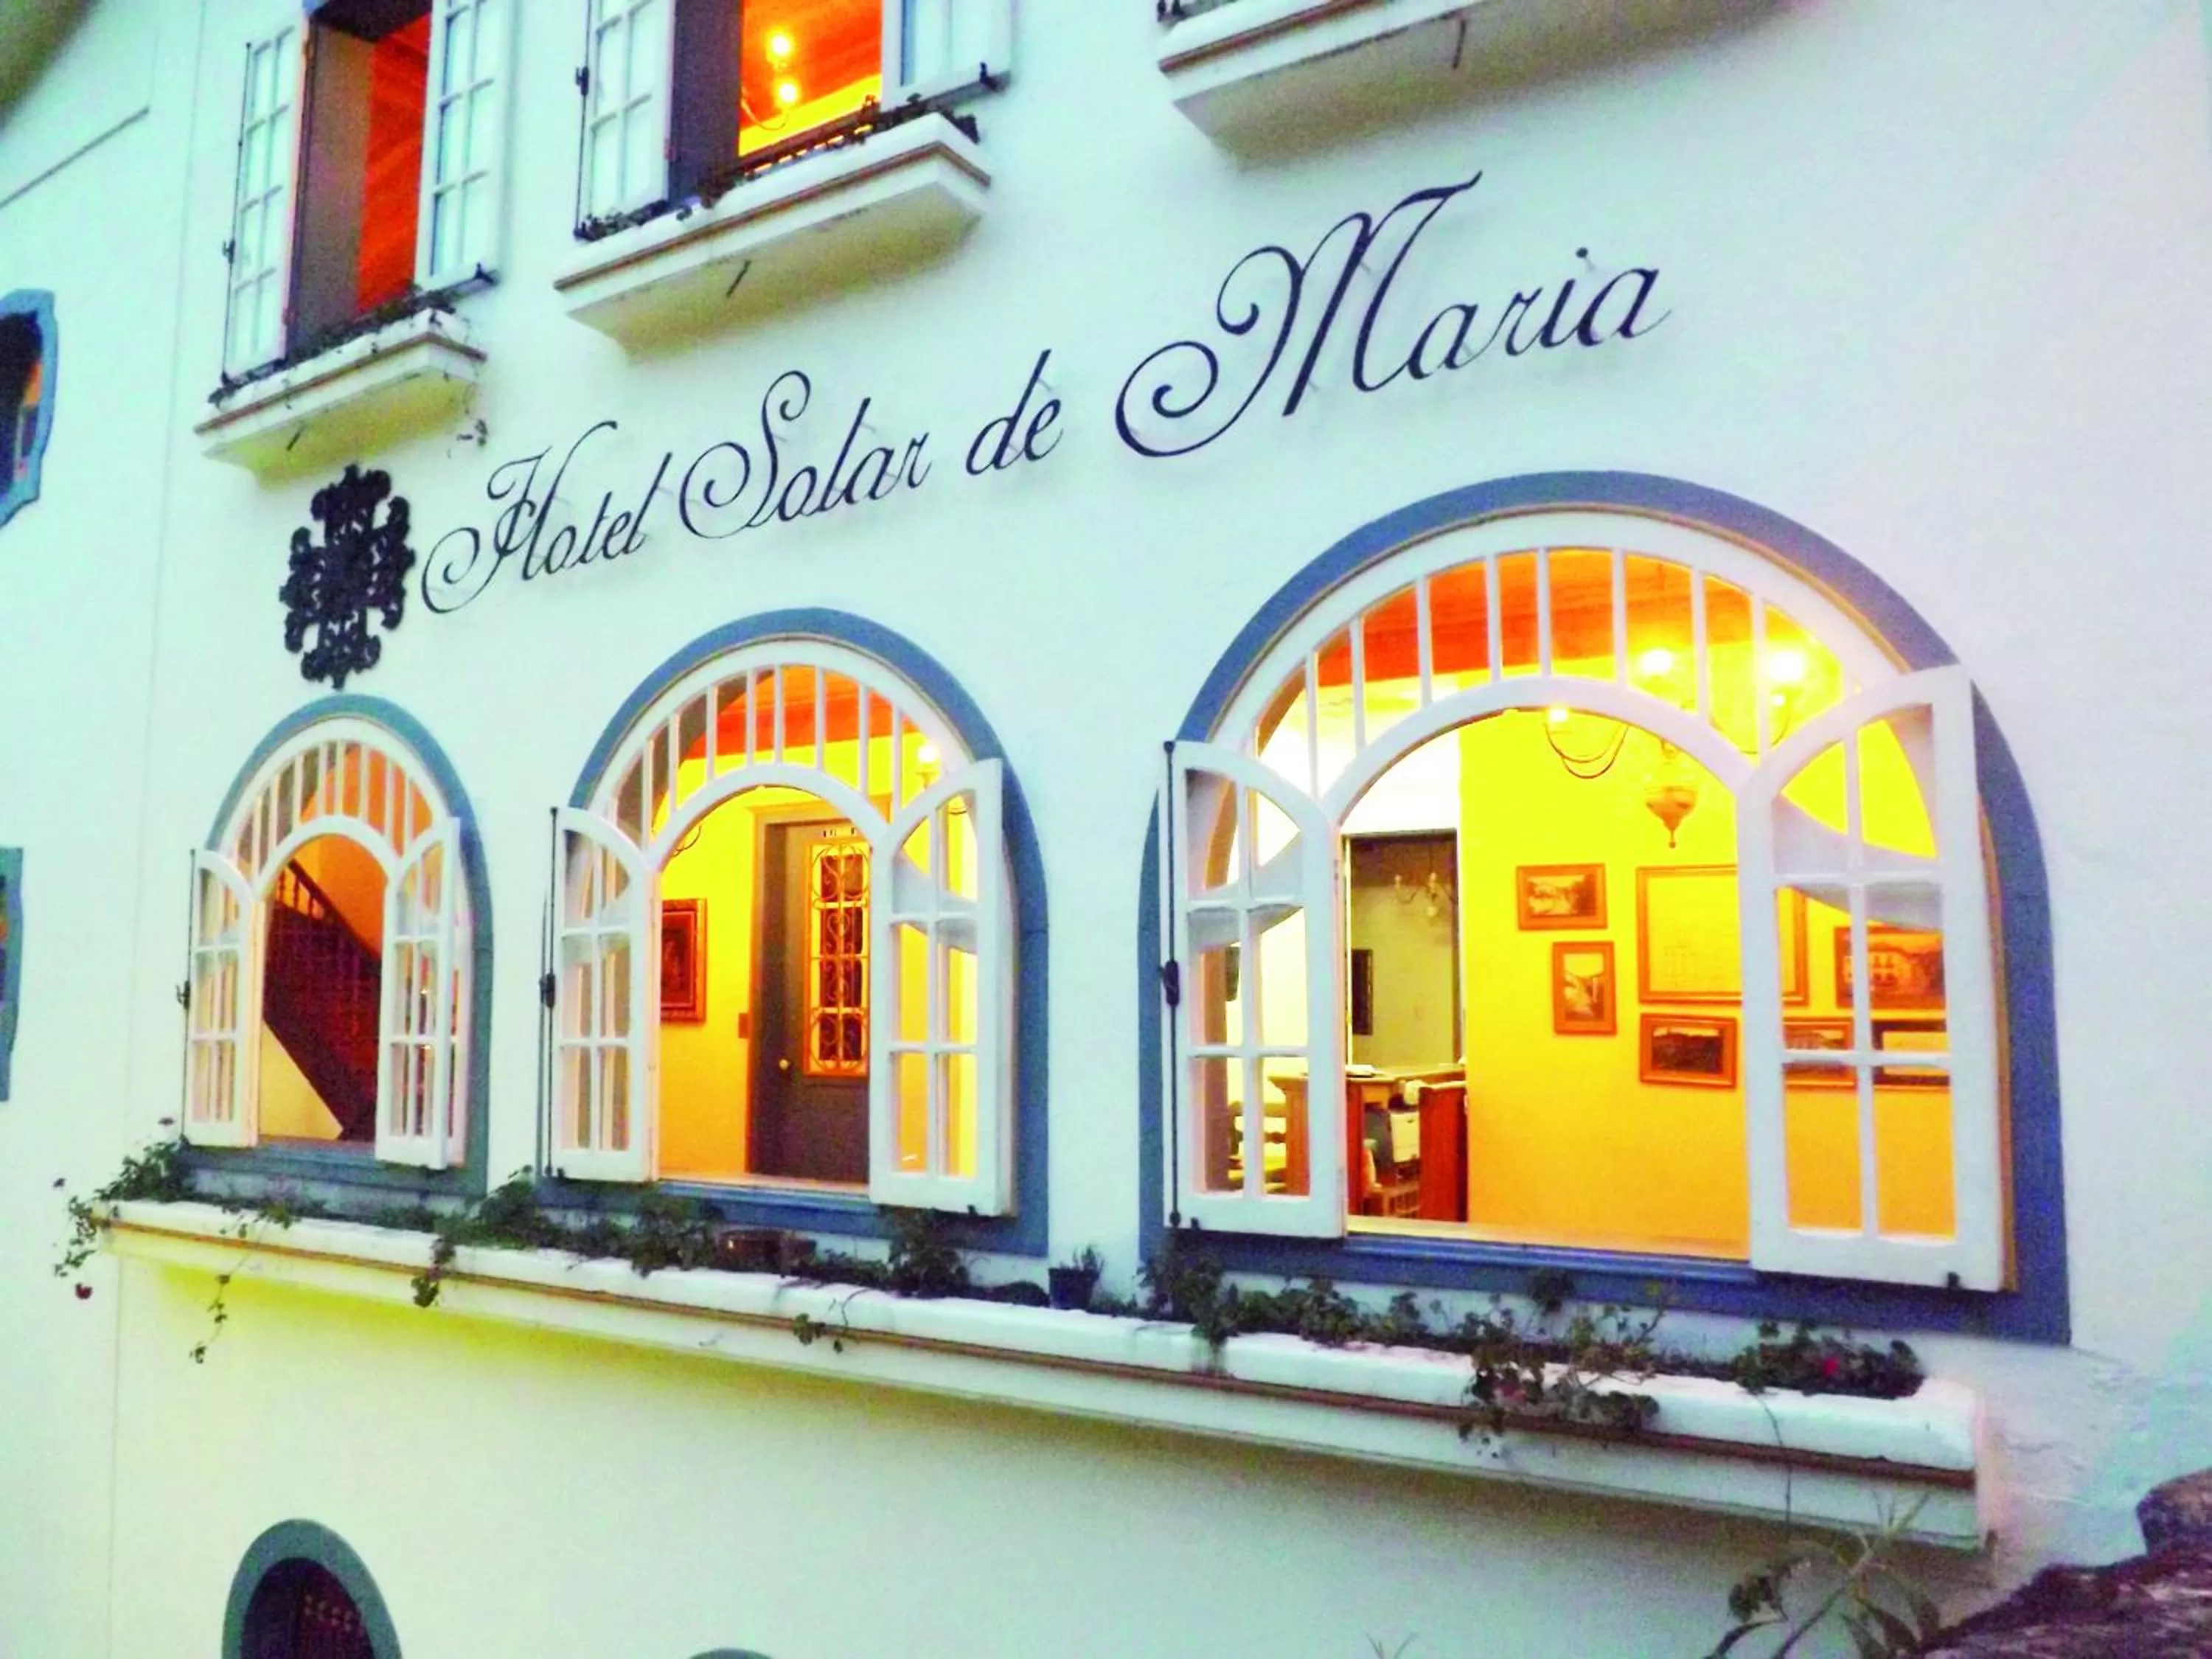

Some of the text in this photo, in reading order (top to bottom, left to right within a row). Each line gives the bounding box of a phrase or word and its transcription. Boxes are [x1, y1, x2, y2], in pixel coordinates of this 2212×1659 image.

[421, 170, 1672, 613] Hotel Solar de Maria
